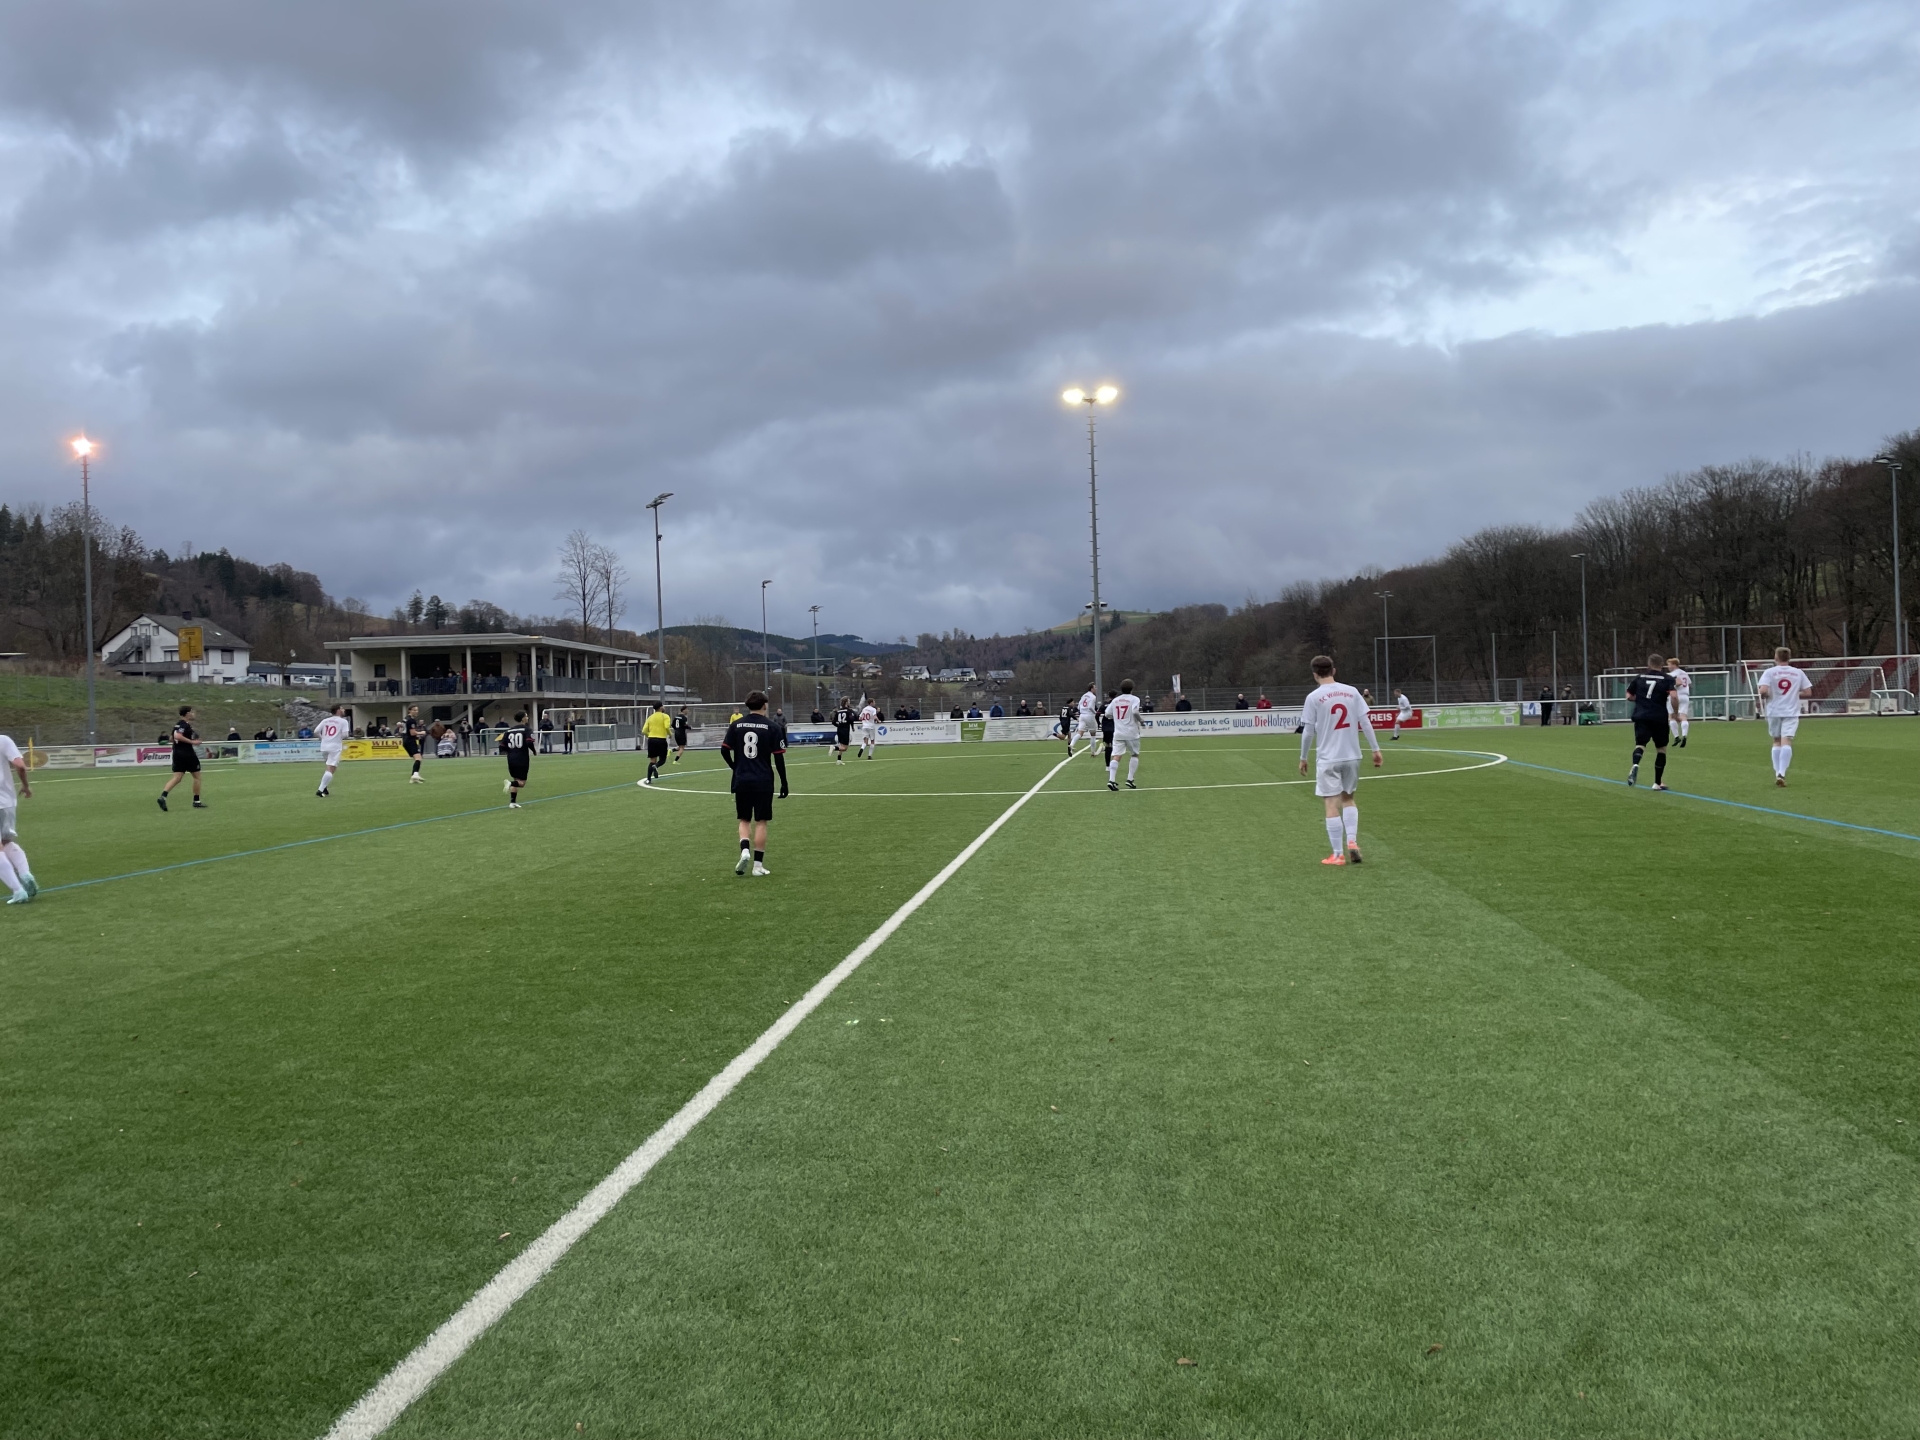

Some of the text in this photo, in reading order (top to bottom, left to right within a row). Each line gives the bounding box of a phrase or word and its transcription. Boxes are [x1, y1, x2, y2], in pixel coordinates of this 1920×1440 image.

[1646, 680, 1656, 699] 7
[1778, 678, 1791, 695] 9
[1082, 699, 1088, 707] 6
[838, 712, 847, 723] 42
[862, 712, 871, 720] 20
[1115, 705, 1128, 720] 17
[1331, 703, 1350, 730] 2
[325, 724, 337, 736] 10
[1156, 719, 1196, 727] Waldecker
[1198, 718, 1217, 726] Bank
[508, 732, 523, 748] 30
[744, 731, 758, 759] 8
